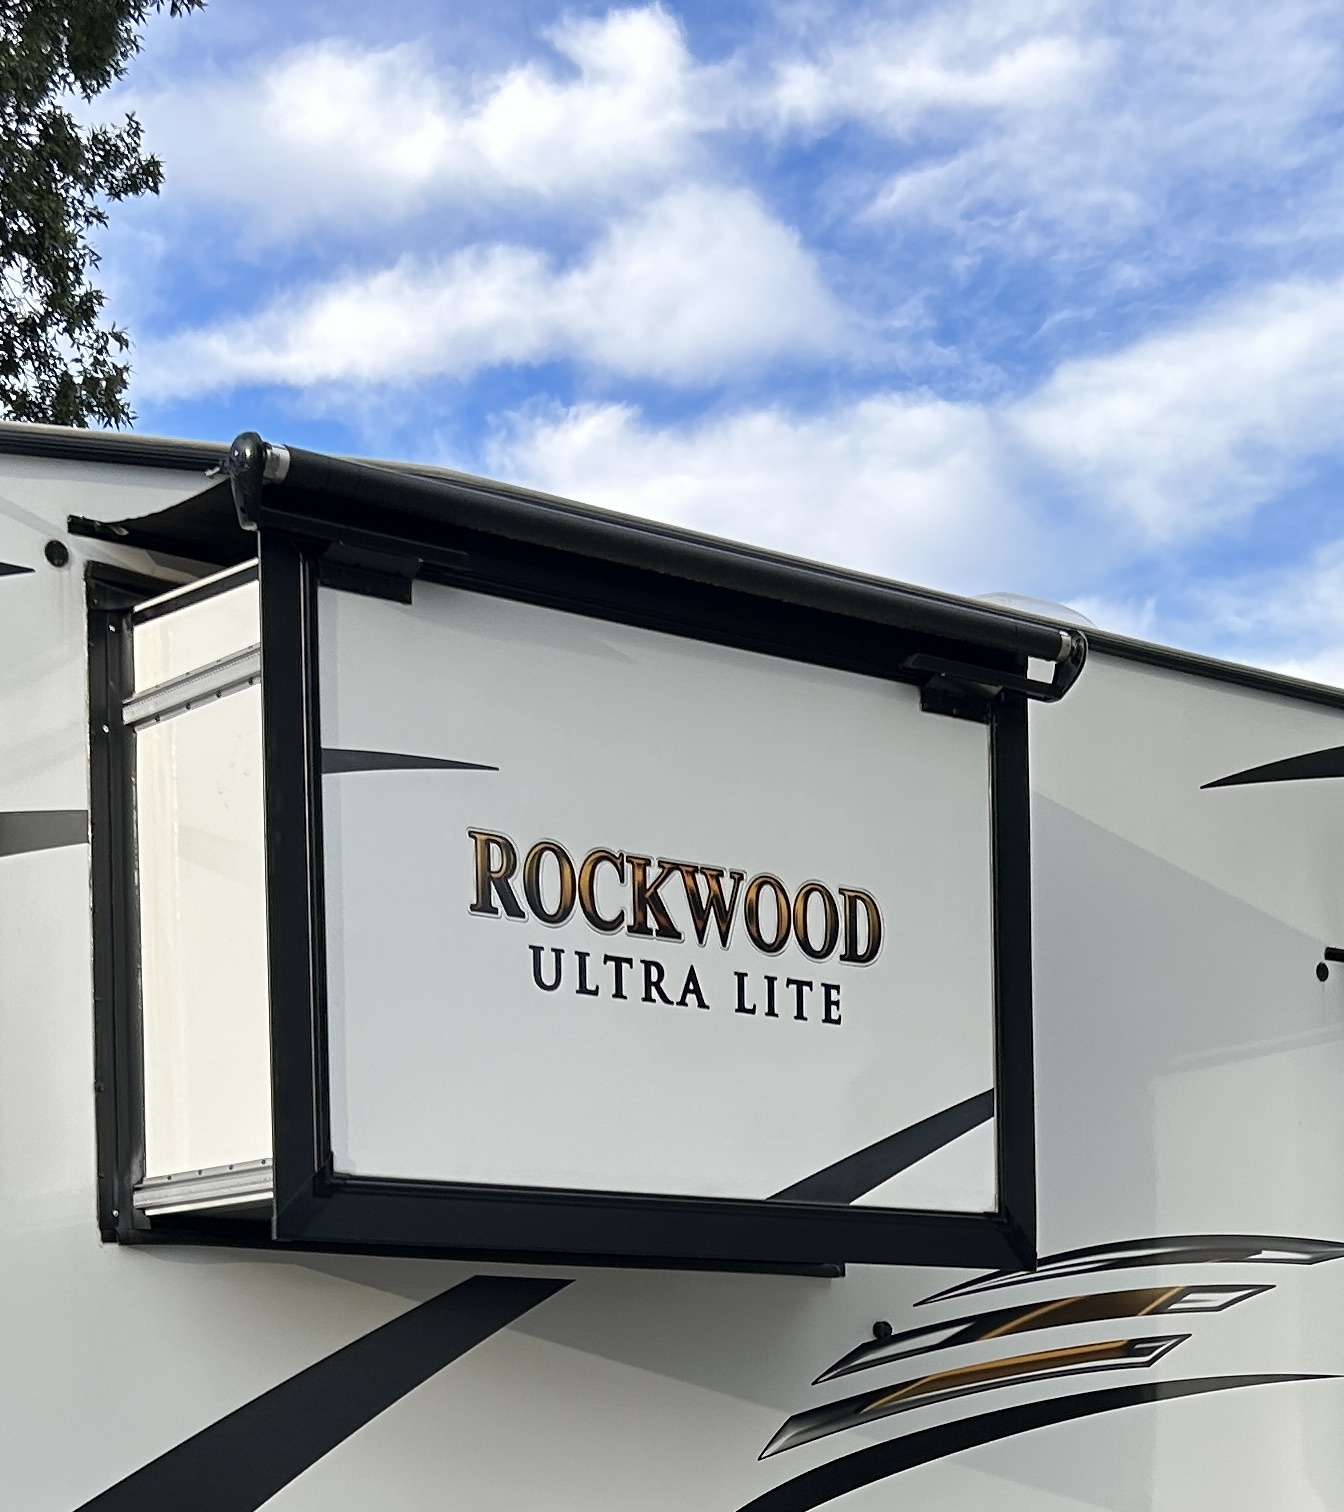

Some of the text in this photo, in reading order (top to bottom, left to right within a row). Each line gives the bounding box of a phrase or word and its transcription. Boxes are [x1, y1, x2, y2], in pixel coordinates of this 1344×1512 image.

[468, 827, 884, 966] ROCKWOOD
[529, 944, 842, 1026] ULTRA LITE
